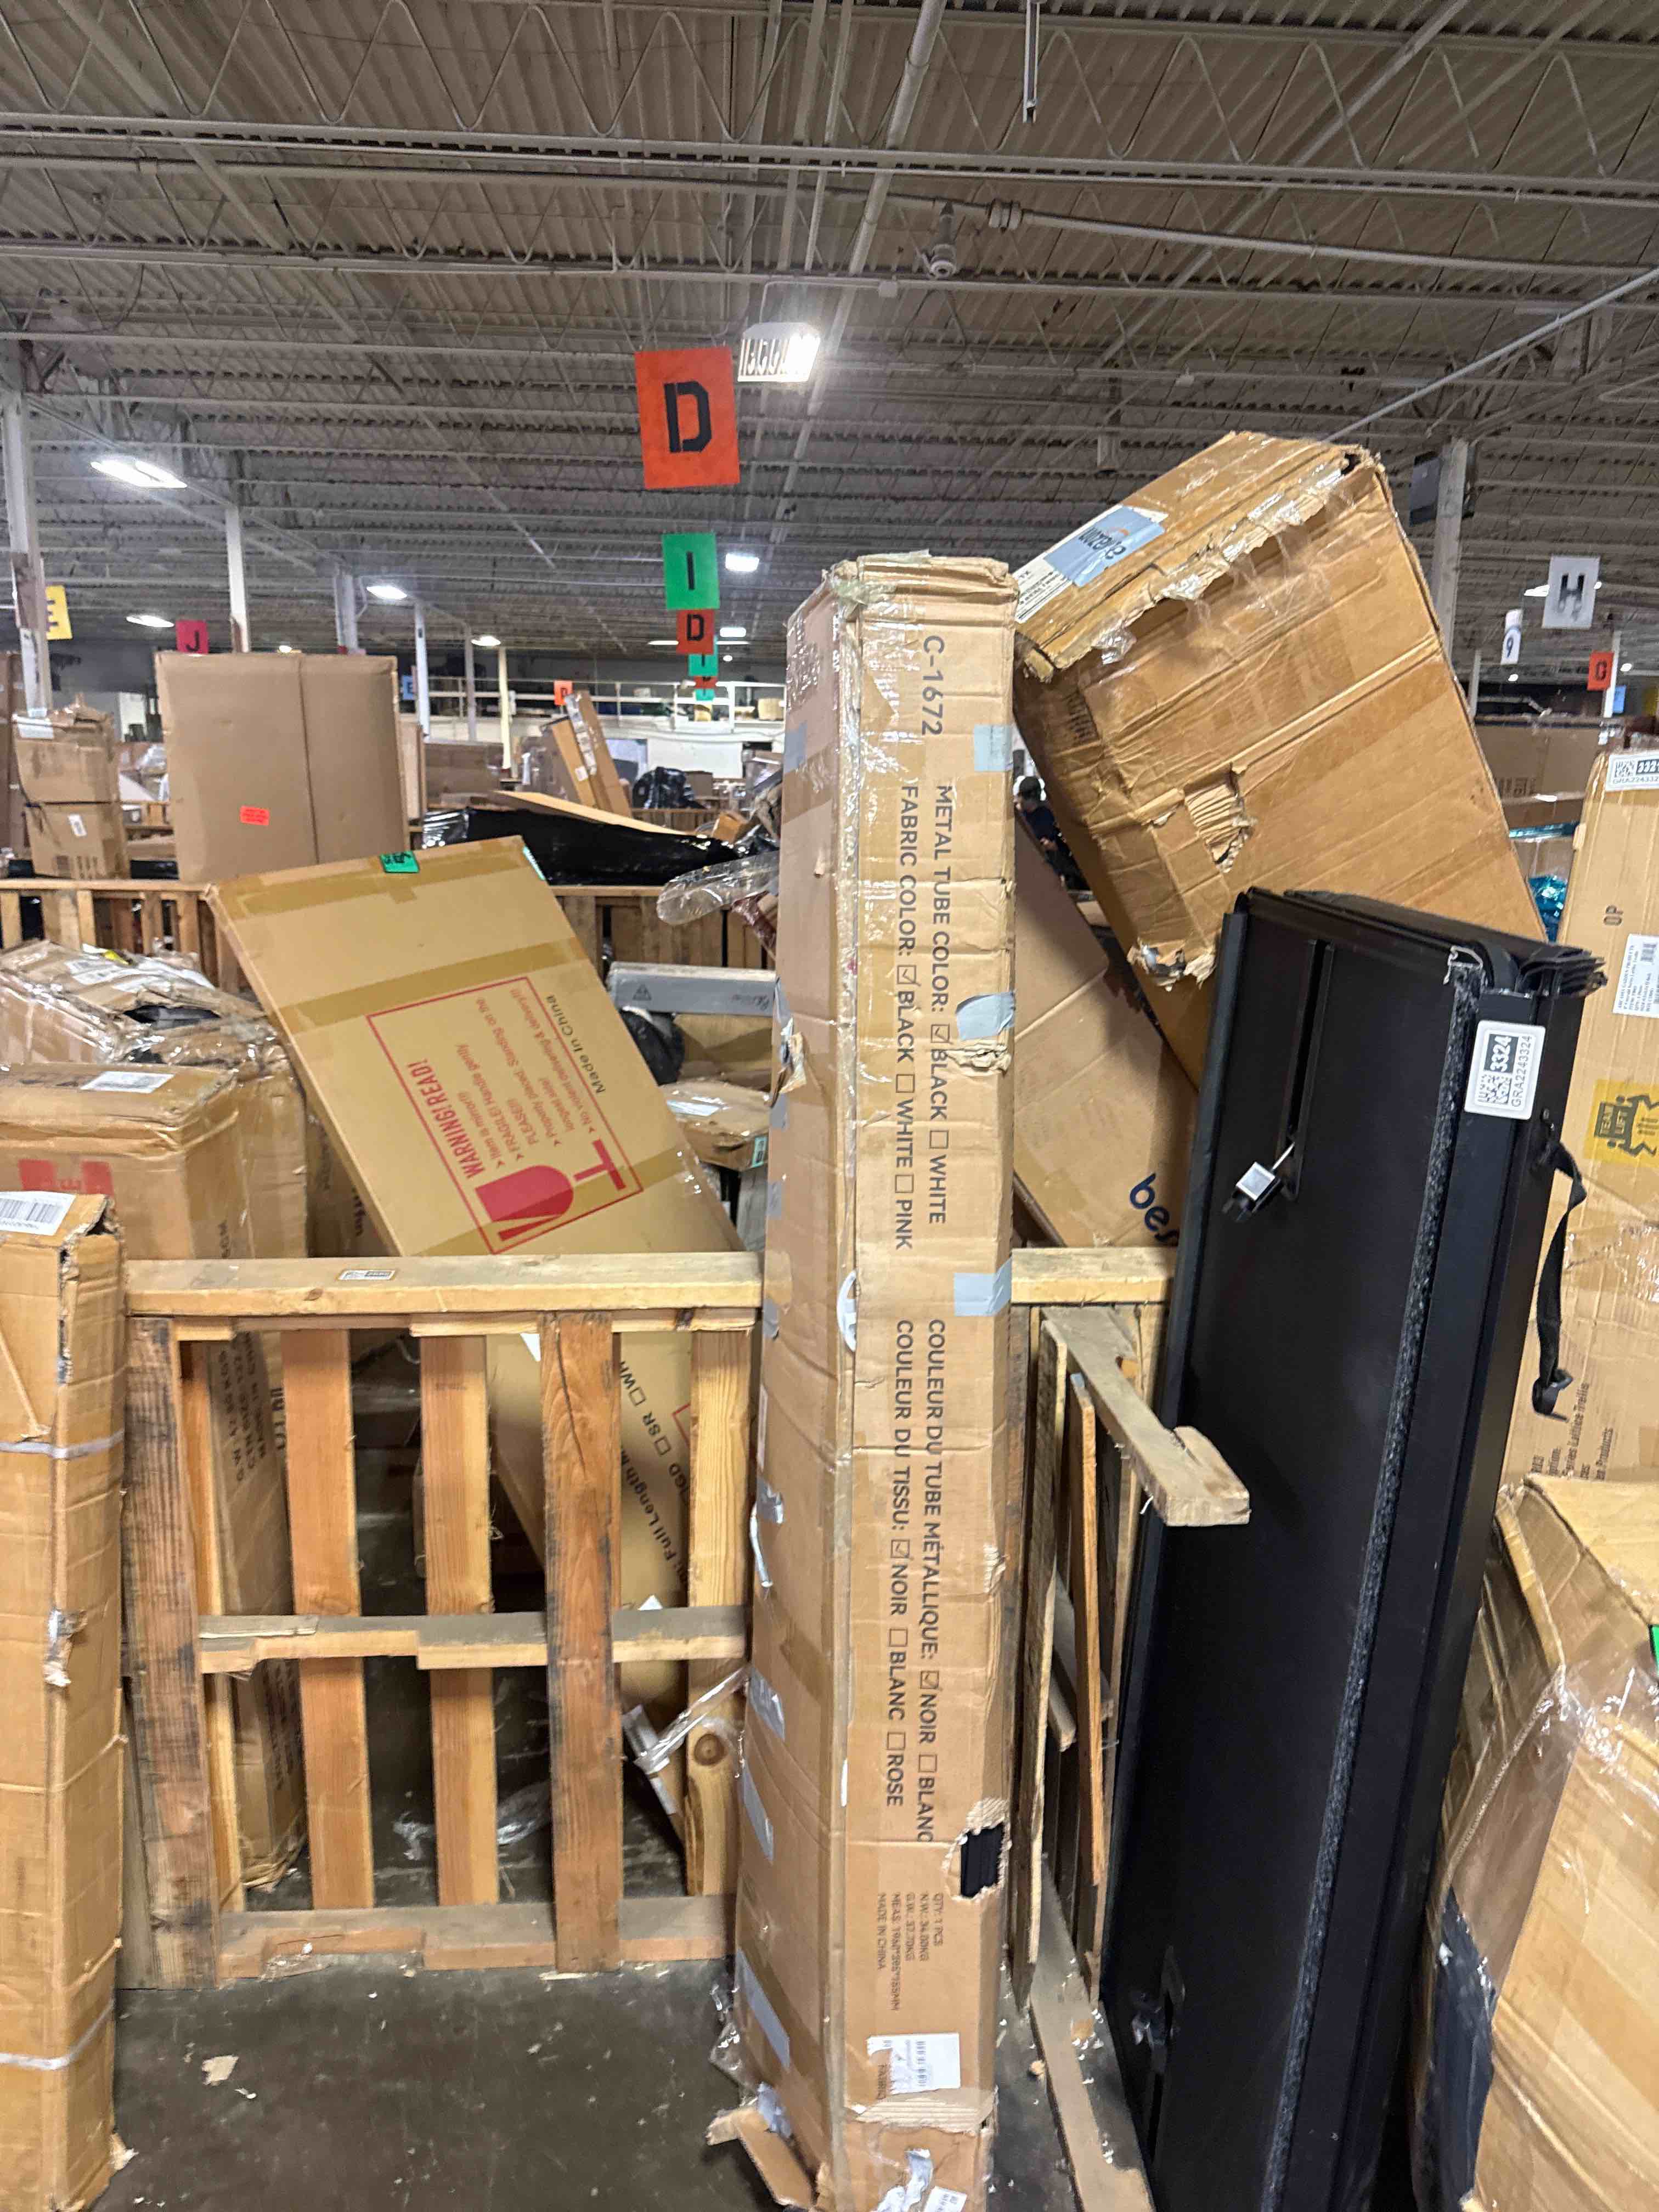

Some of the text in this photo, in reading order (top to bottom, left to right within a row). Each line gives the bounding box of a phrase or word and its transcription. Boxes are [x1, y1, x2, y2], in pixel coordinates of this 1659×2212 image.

[664, 381, 712, 453] D
[686, 552, 695, 590] I
[185, 631, 200, 652] J
[687, 614, 704, 641] D
[921, 635, 945, 736] C-1672
[546, 994, 573, 1036] China
[895, 786, 919, 1251] FABRIC COLOR: BLACK WHITE PINK
[928, 785, 953, 1224] METAL TUBE COLOR: BLACK WHITE
[578, 1053, 605, 1093] Made
[1489, 1036, 1511, 1073] 3324
[1511, 1035, 1533, 1107] GRA2243324
[408, 1057, 486, 1178] WARNING! READ!
[926, 1319, 945, 1420] COULEUR
[640, 1410, 662, 1437] SR
[926, 1426, 944, 1455] DU
[623, 1464, 678, 1562] Full Length
[923, 1462, 943, 1516] TUBE
[886, 1319, 914, 1807] COULEUR DU TISSU: NOIR BLANC ROSE
[918, 1694, 938, 1745] NOIR
[917, 1776, 935, 1843] BLANC
[877, 1892, 886, 1971] MADE IN CHINA
